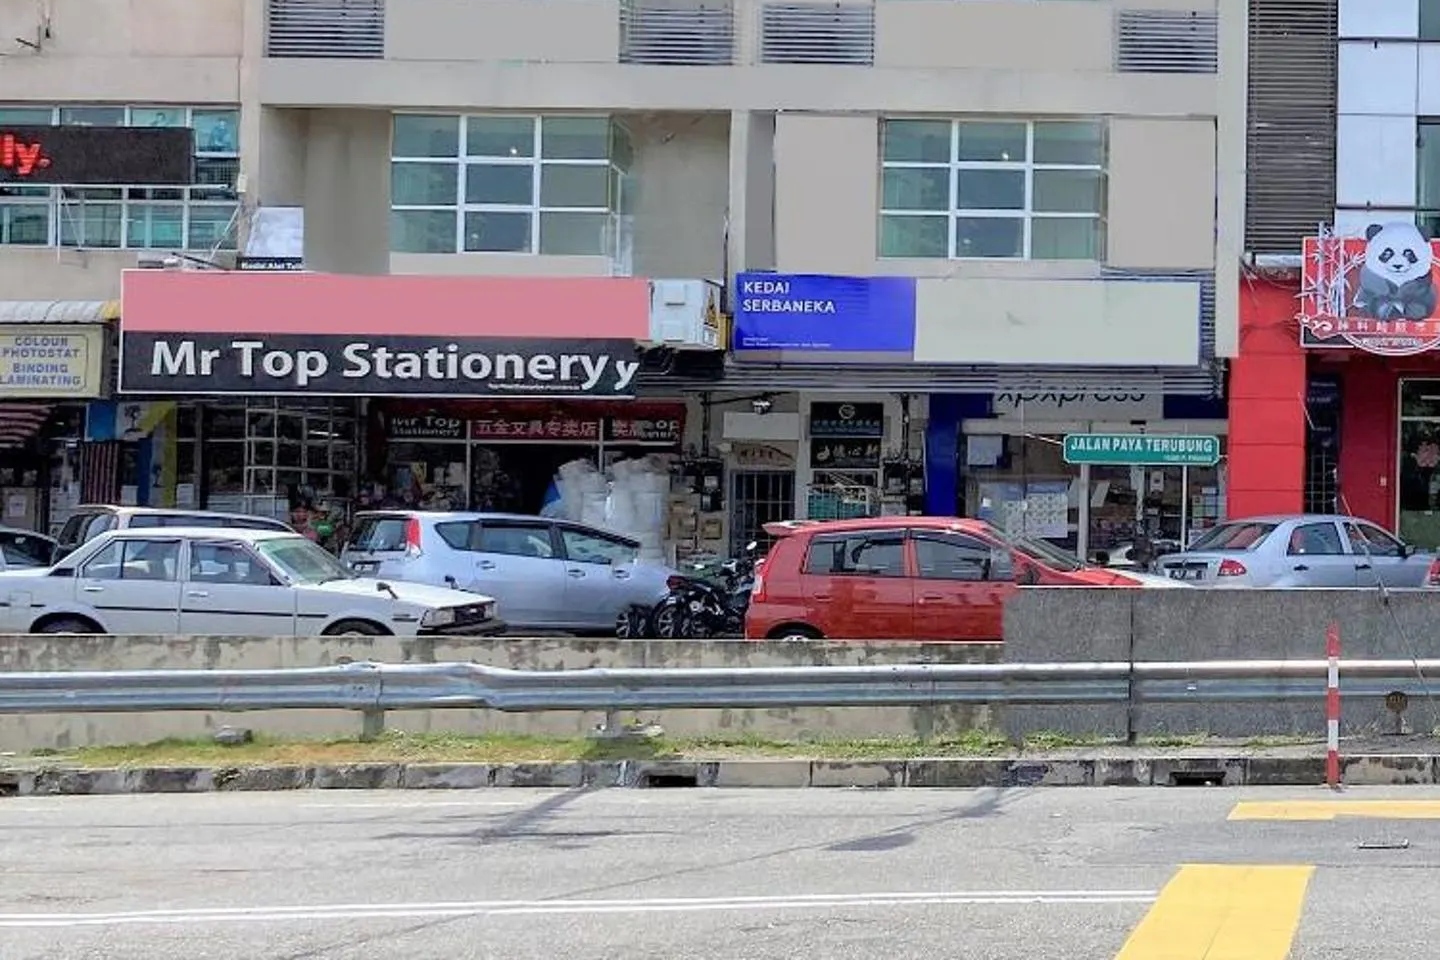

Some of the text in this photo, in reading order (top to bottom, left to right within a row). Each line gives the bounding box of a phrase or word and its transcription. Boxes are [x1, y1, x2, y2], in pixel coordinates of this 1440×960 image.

[744, 281, 790, 295] KEDAI
[743, 299, 836, 314] SERBANEKA
[2, 348, 80, 358] PHOTOSTAT
[13, 363, 69, 373] BINDING
[150, 341, 220, 377] Mr
[232, 341, 328, 386] Top
[343, 343, 607, 390] Stationery
[1071, 438, 1213, 453] JALAN PAYA TERUBUNG
